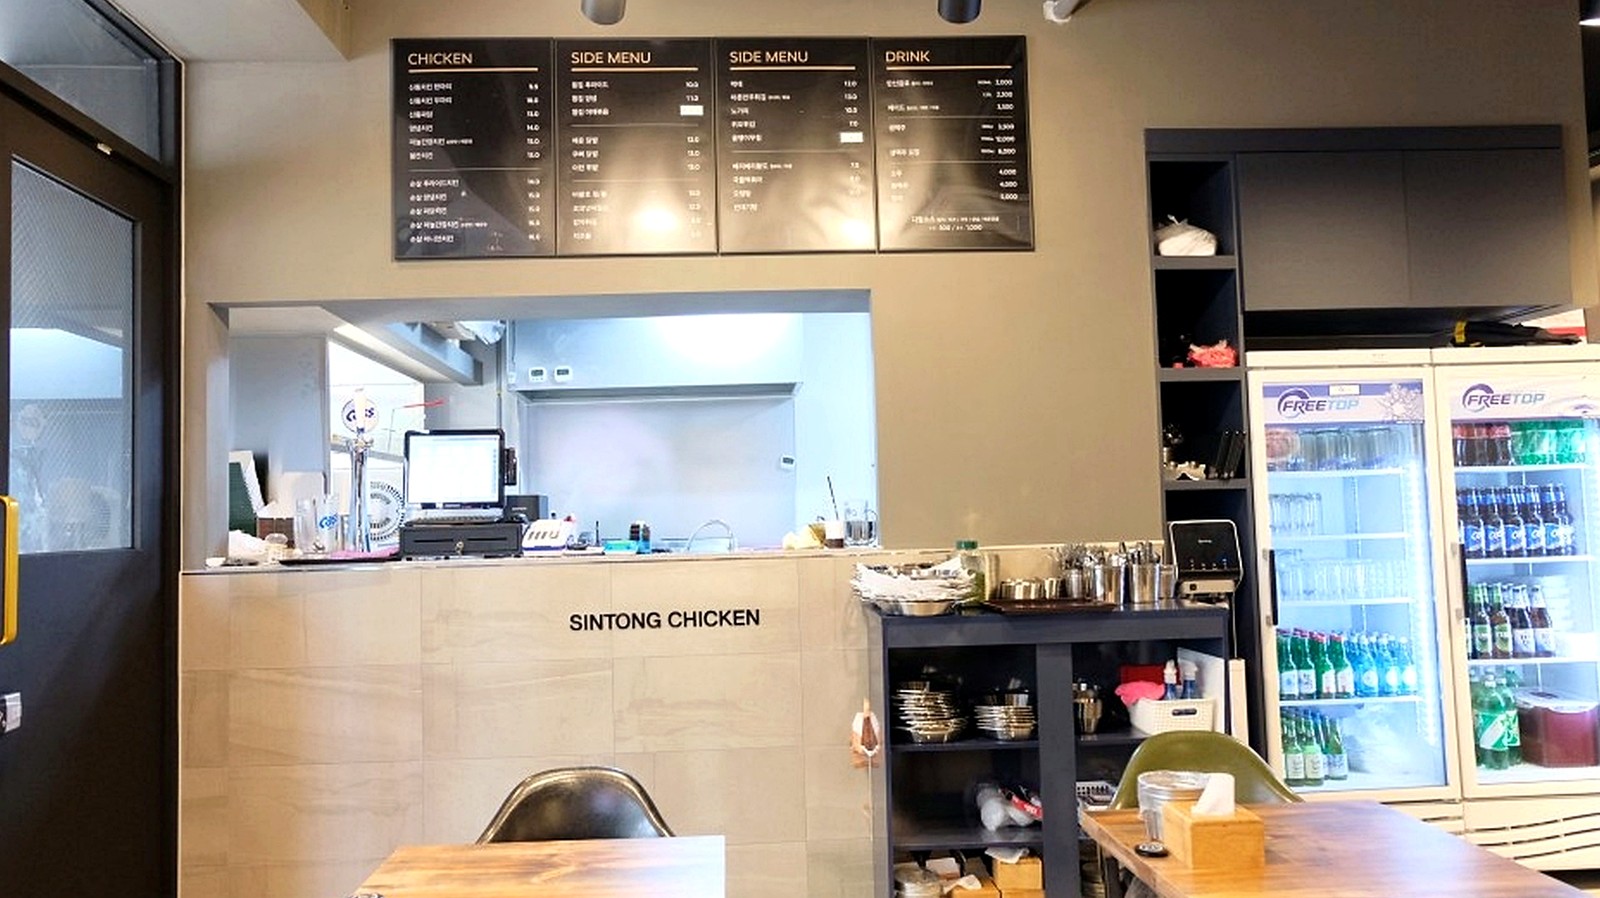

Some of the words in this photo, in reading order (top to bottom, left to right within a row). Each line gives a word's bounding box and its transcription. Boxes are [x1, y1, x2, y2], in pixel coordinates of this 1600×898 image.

[408, 53, 473, 65] CHICKEN
[571, 52, 604, 64] SIDE
[607, 52, 651, 64] MENU
[729, 51, 762, 63] SIDE
[765, 51, 809, 63] MENU
[885, 51, 930, 62] DRINK
[1282, 398, 1359, 414] FREETOP
[1466, 393, 1546, 408] FREETOP
[570, 612, 661, 631] SINTONG
[668, 609, 760, 628] CHICKEN
